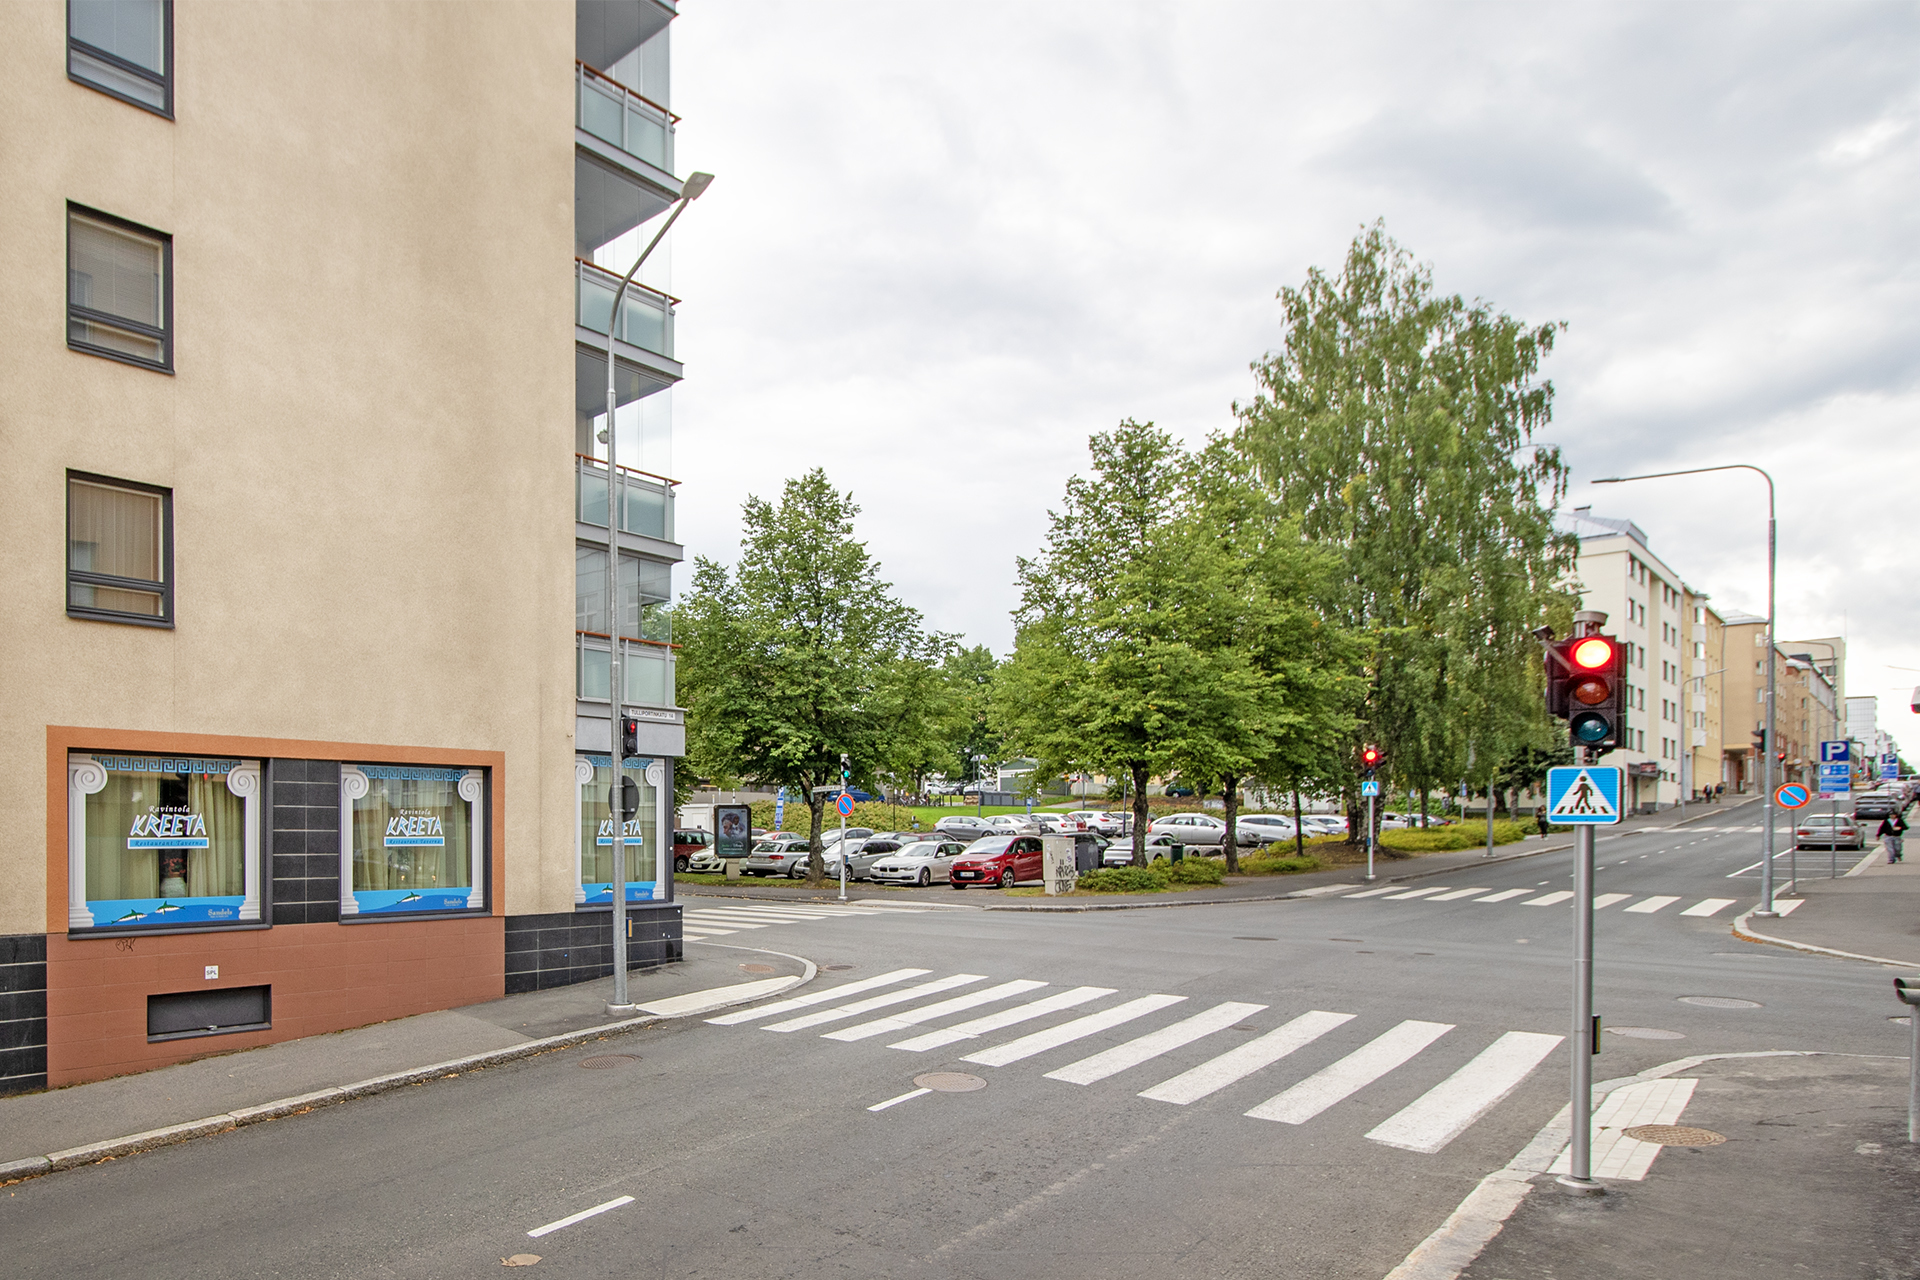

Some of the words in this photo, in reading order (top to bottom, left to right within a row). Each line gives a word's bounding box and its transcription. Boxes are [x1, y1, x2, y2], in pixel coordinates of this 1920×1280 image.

[149, 804, 190, 813] Ravintola
[130, 813, 207, 837] KREETA
[386, 816, 443, 836] KREETA
[598, 819, 642, 836] KRETA
[134, 839, 173, 847] Restaurant
[208, 908, 233, 916] Sandels
